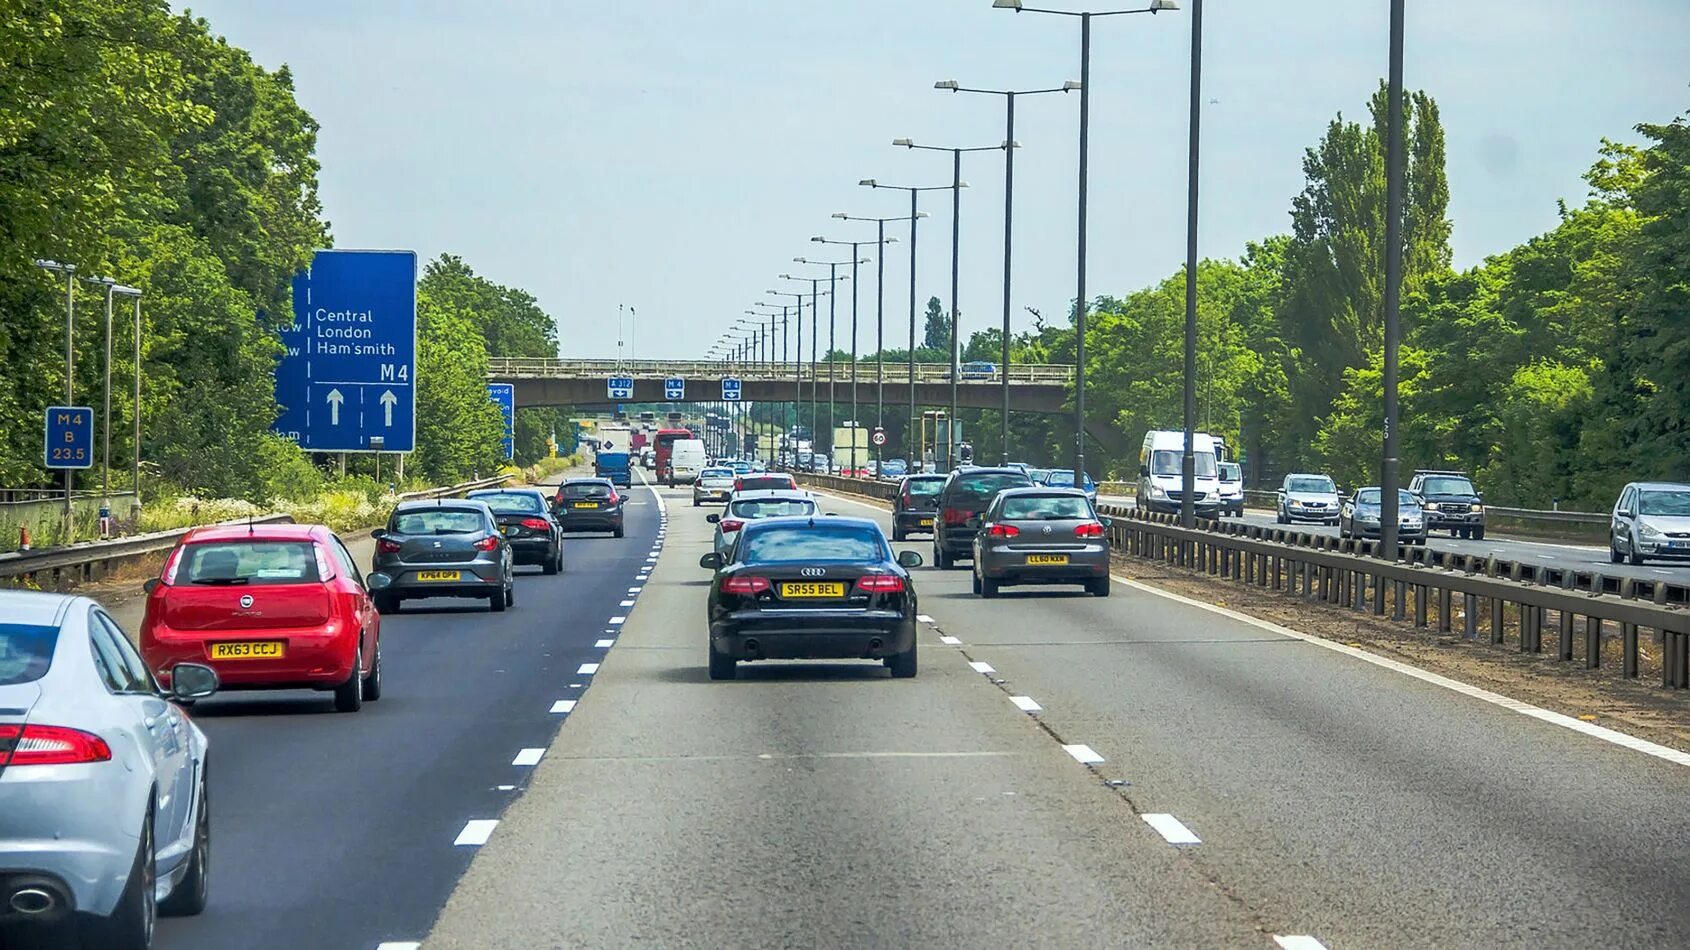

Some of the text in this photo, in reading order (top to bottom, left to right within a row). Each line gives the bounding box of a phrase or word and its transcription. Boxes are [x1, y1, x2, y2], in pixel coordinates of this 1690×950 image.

[315, 308, 373, 322] Central
[317, 325, 372, 338] London
[317, 341, 395, 355] Ham'smith
[65, 431, 74, 443] B
[53, 447, 85, 460] 23.5
[787, 584, 838, 594] SR55 BEL
[218, 643, 277, 656] RX63 CCJ
